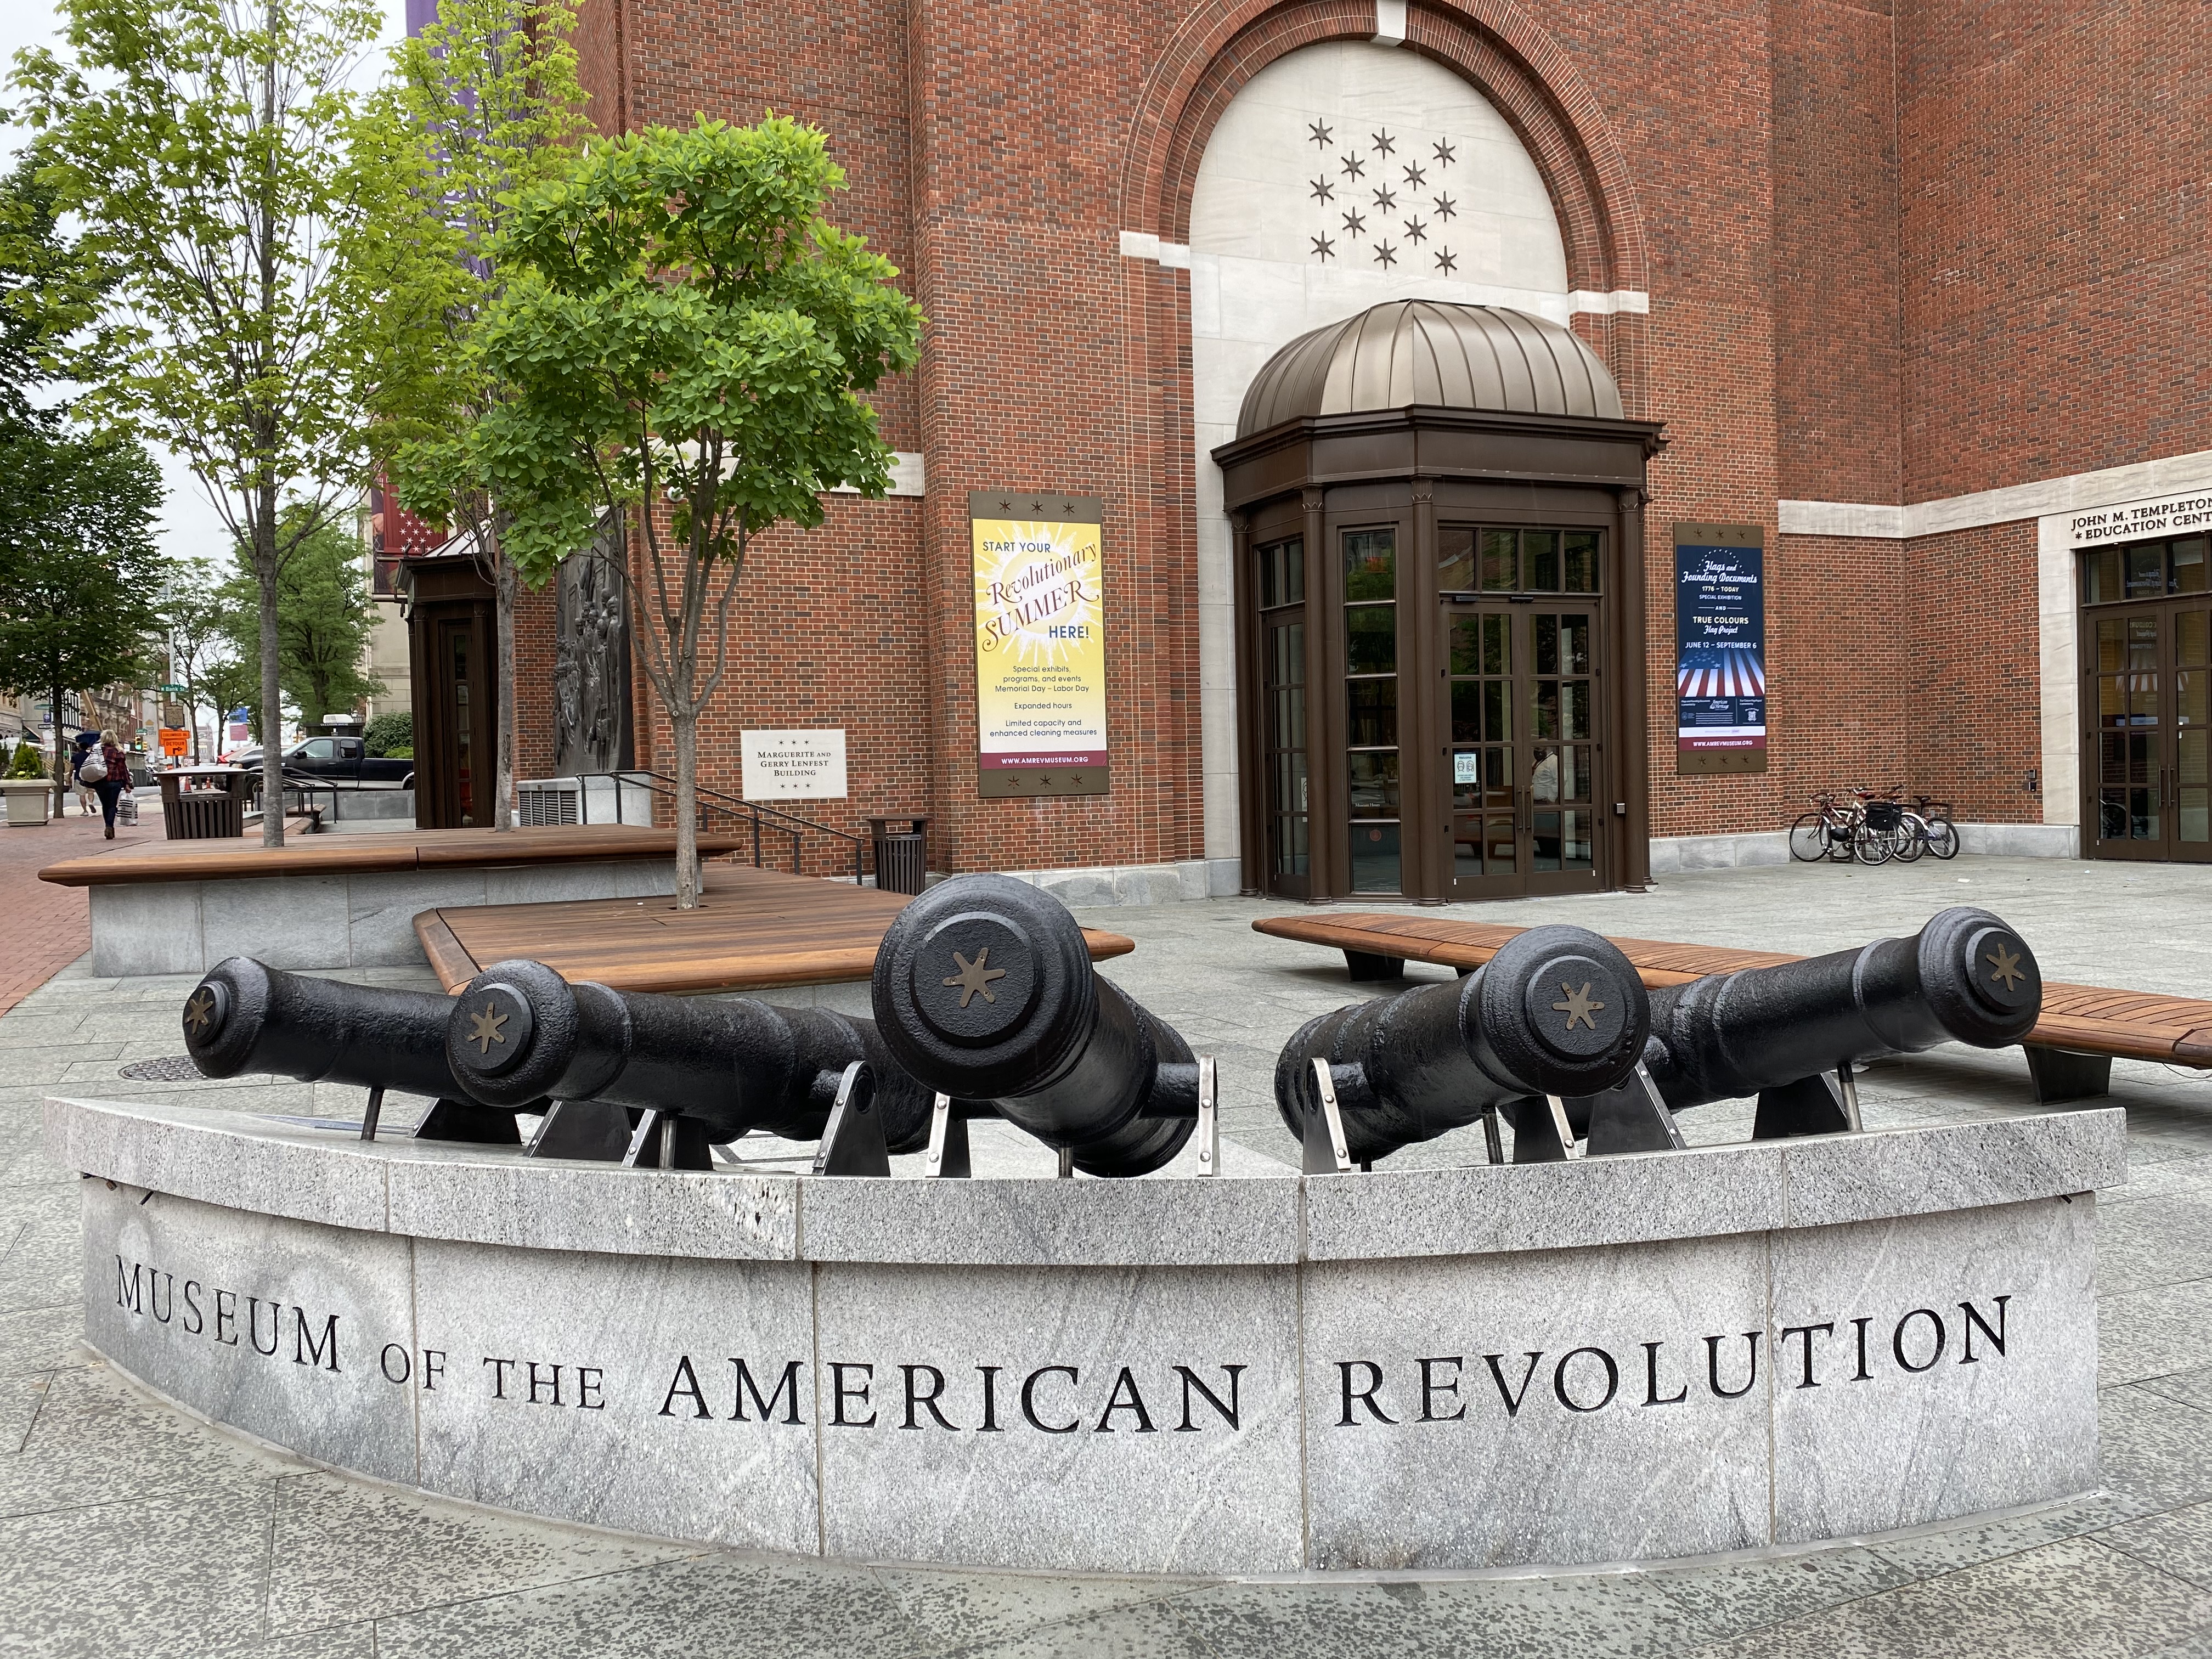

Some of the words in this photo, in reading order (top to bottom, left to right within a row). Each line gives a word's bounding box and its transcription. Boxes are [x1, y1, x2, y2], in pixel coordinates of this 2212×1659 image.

[2071, 514, 2107, 531] JOHN
[2113, 511, 2128, 522] M.
[2085, 518, 2166, 539] EDUCATION
[983, 541, 1015, 552] START
[1019, 542, 1051, 553] YOUR
[1703, 560, 1725, 573] Flags
[986, 543, 1096, 606] Revolutionary
[1681, 571, 1718, 584] Founding
[1719, 573, 1757, 583] Documents
[982, 580, 1099, 652] SUMMER
[1049, 625, 1089, 639] HERE!
[1703, 625, 1717, 635] Flag
[1718, 625, 1739, 635] Project
[1013, 665, 1040, 674] Special
[1031, 685, 1046, 693] Day
[1075, 685, 1089, 693] Day
[1034, 719, 1065, 727] capacity
[115, 1254, 342, 1373] MUSEUM
[381, 1343, 446, 1391] OF
[483, 1357, 605, 1410] THE
[657, 1355, 1248, 1434] AMERICAN
[1334, 1295, 2012, 1427] REVOLUTION
